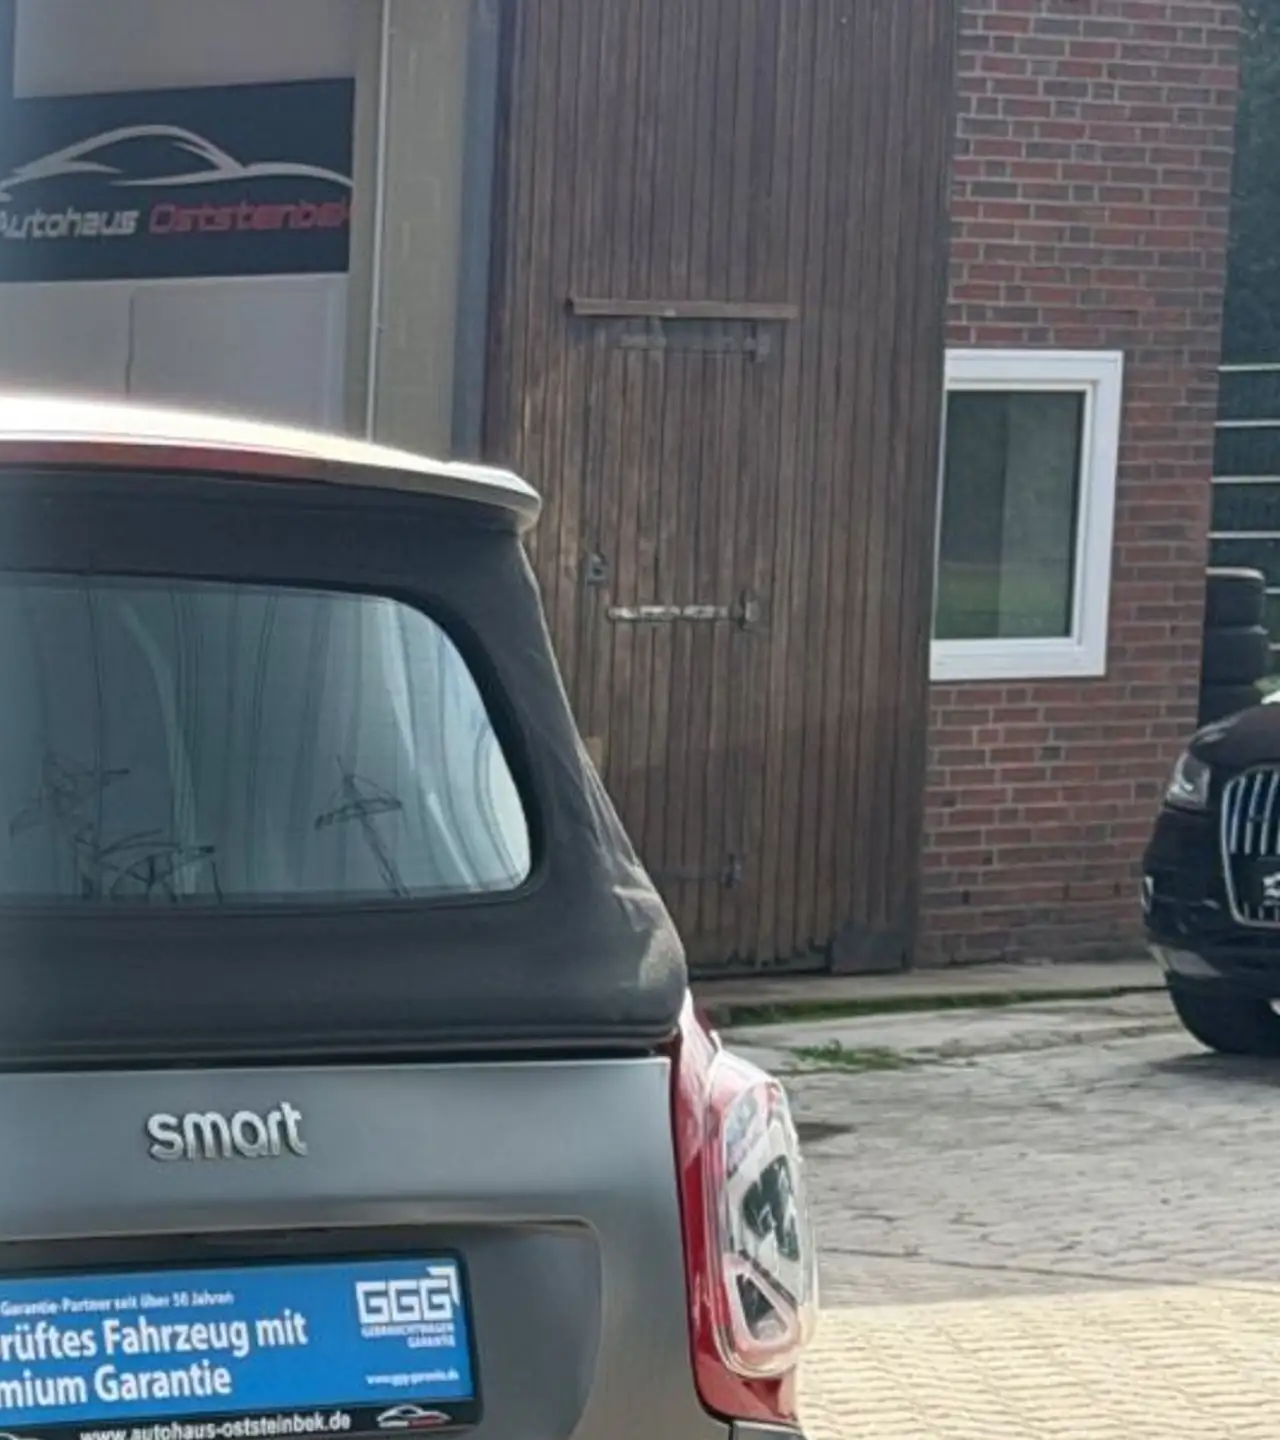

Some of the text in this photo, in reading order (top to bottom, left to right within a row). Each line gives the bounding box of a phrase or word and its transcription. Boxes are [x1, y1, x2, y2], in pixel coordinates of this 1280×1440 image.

[146, 1101, 308, 1161] smart
[115, 1295, 138, 1311] seit
[191, 1290, 235, 1306] Jahren
[354, 1277, 455, 1325] GGG
[101, 1314, 250, 1358] Fahrzeug
[255, 1308, 309, 1348] mit
[93, 1357, 234, 1403] Garantie
